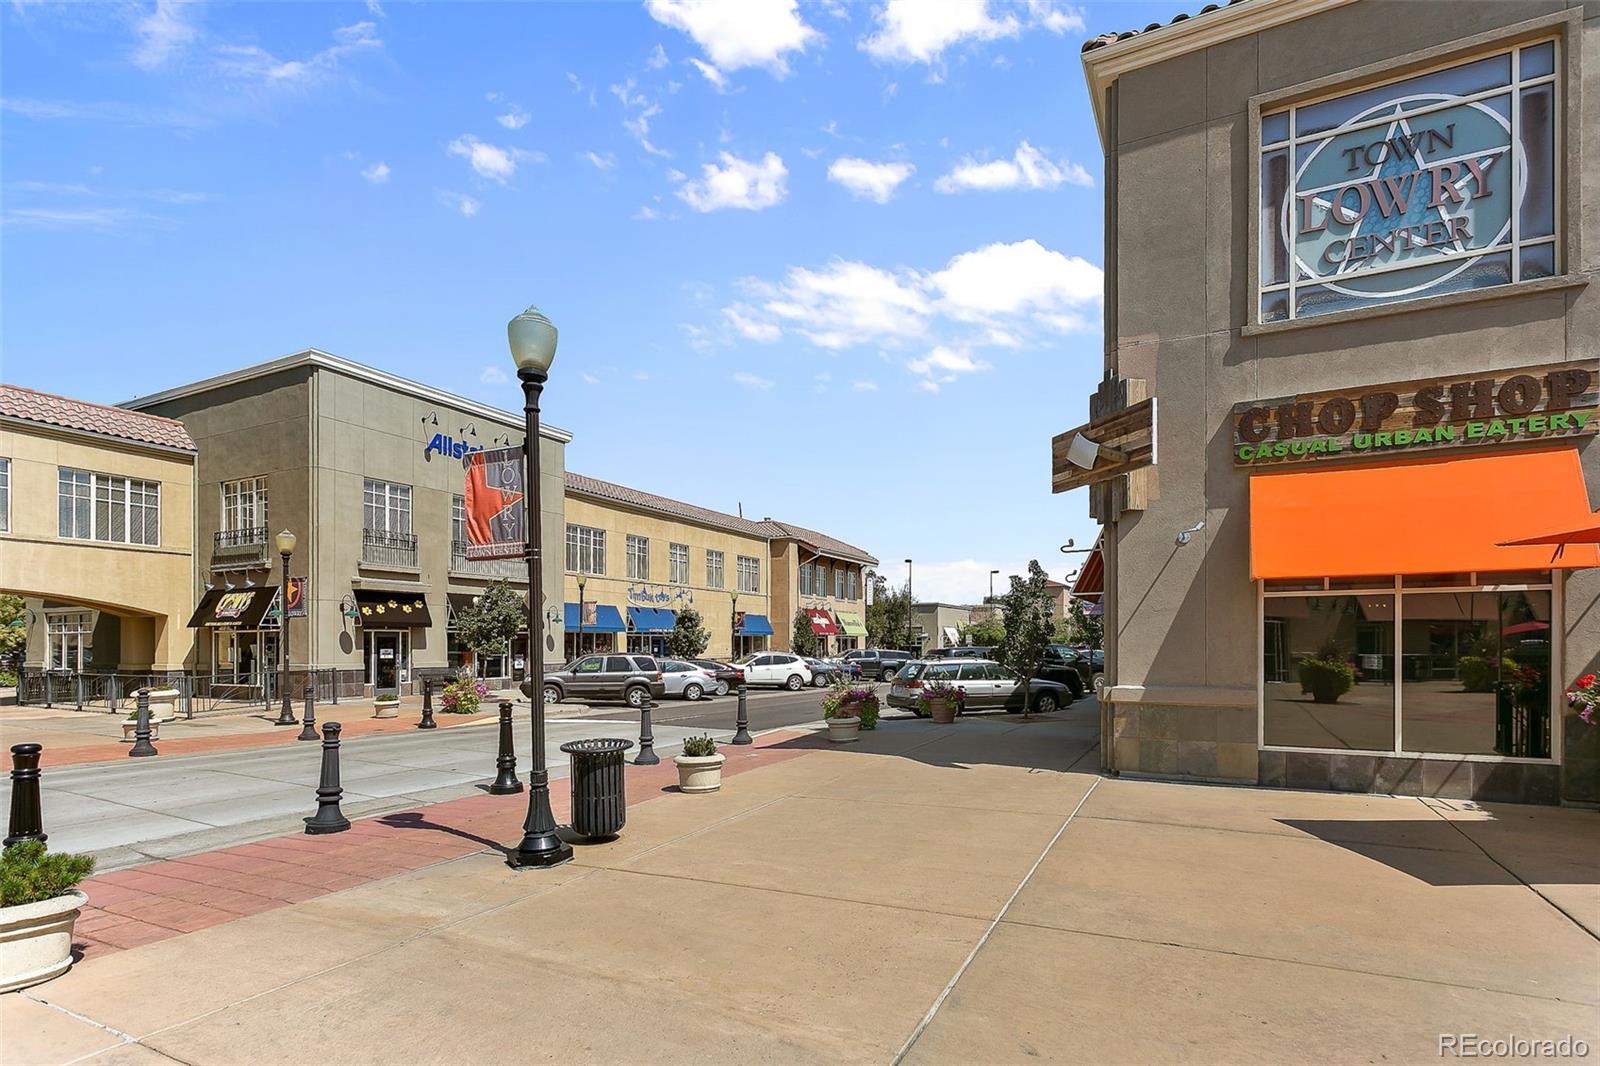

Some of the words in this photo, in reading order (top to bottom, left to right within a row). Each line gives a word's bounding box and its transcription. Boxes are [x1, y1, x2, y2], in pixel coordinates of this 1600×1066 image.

[1342, 124, 1456, 172] TOWN
[1298, 152, 1503, 234] LOWRY
[1324, 216, 1474, 265] CENTER
[1238, 392, 1400, 442] CHOP
[1412, 368, 1592, 426] SHOP
[428, 433, 485, 460] Allst
[1238, 438, 1343, 461] CASUAL
[1353, 425, 1455, 450] URBAN
[1467, 411, 1593, 439] EATERY
[501, 450, 519, 540] LOWRY
